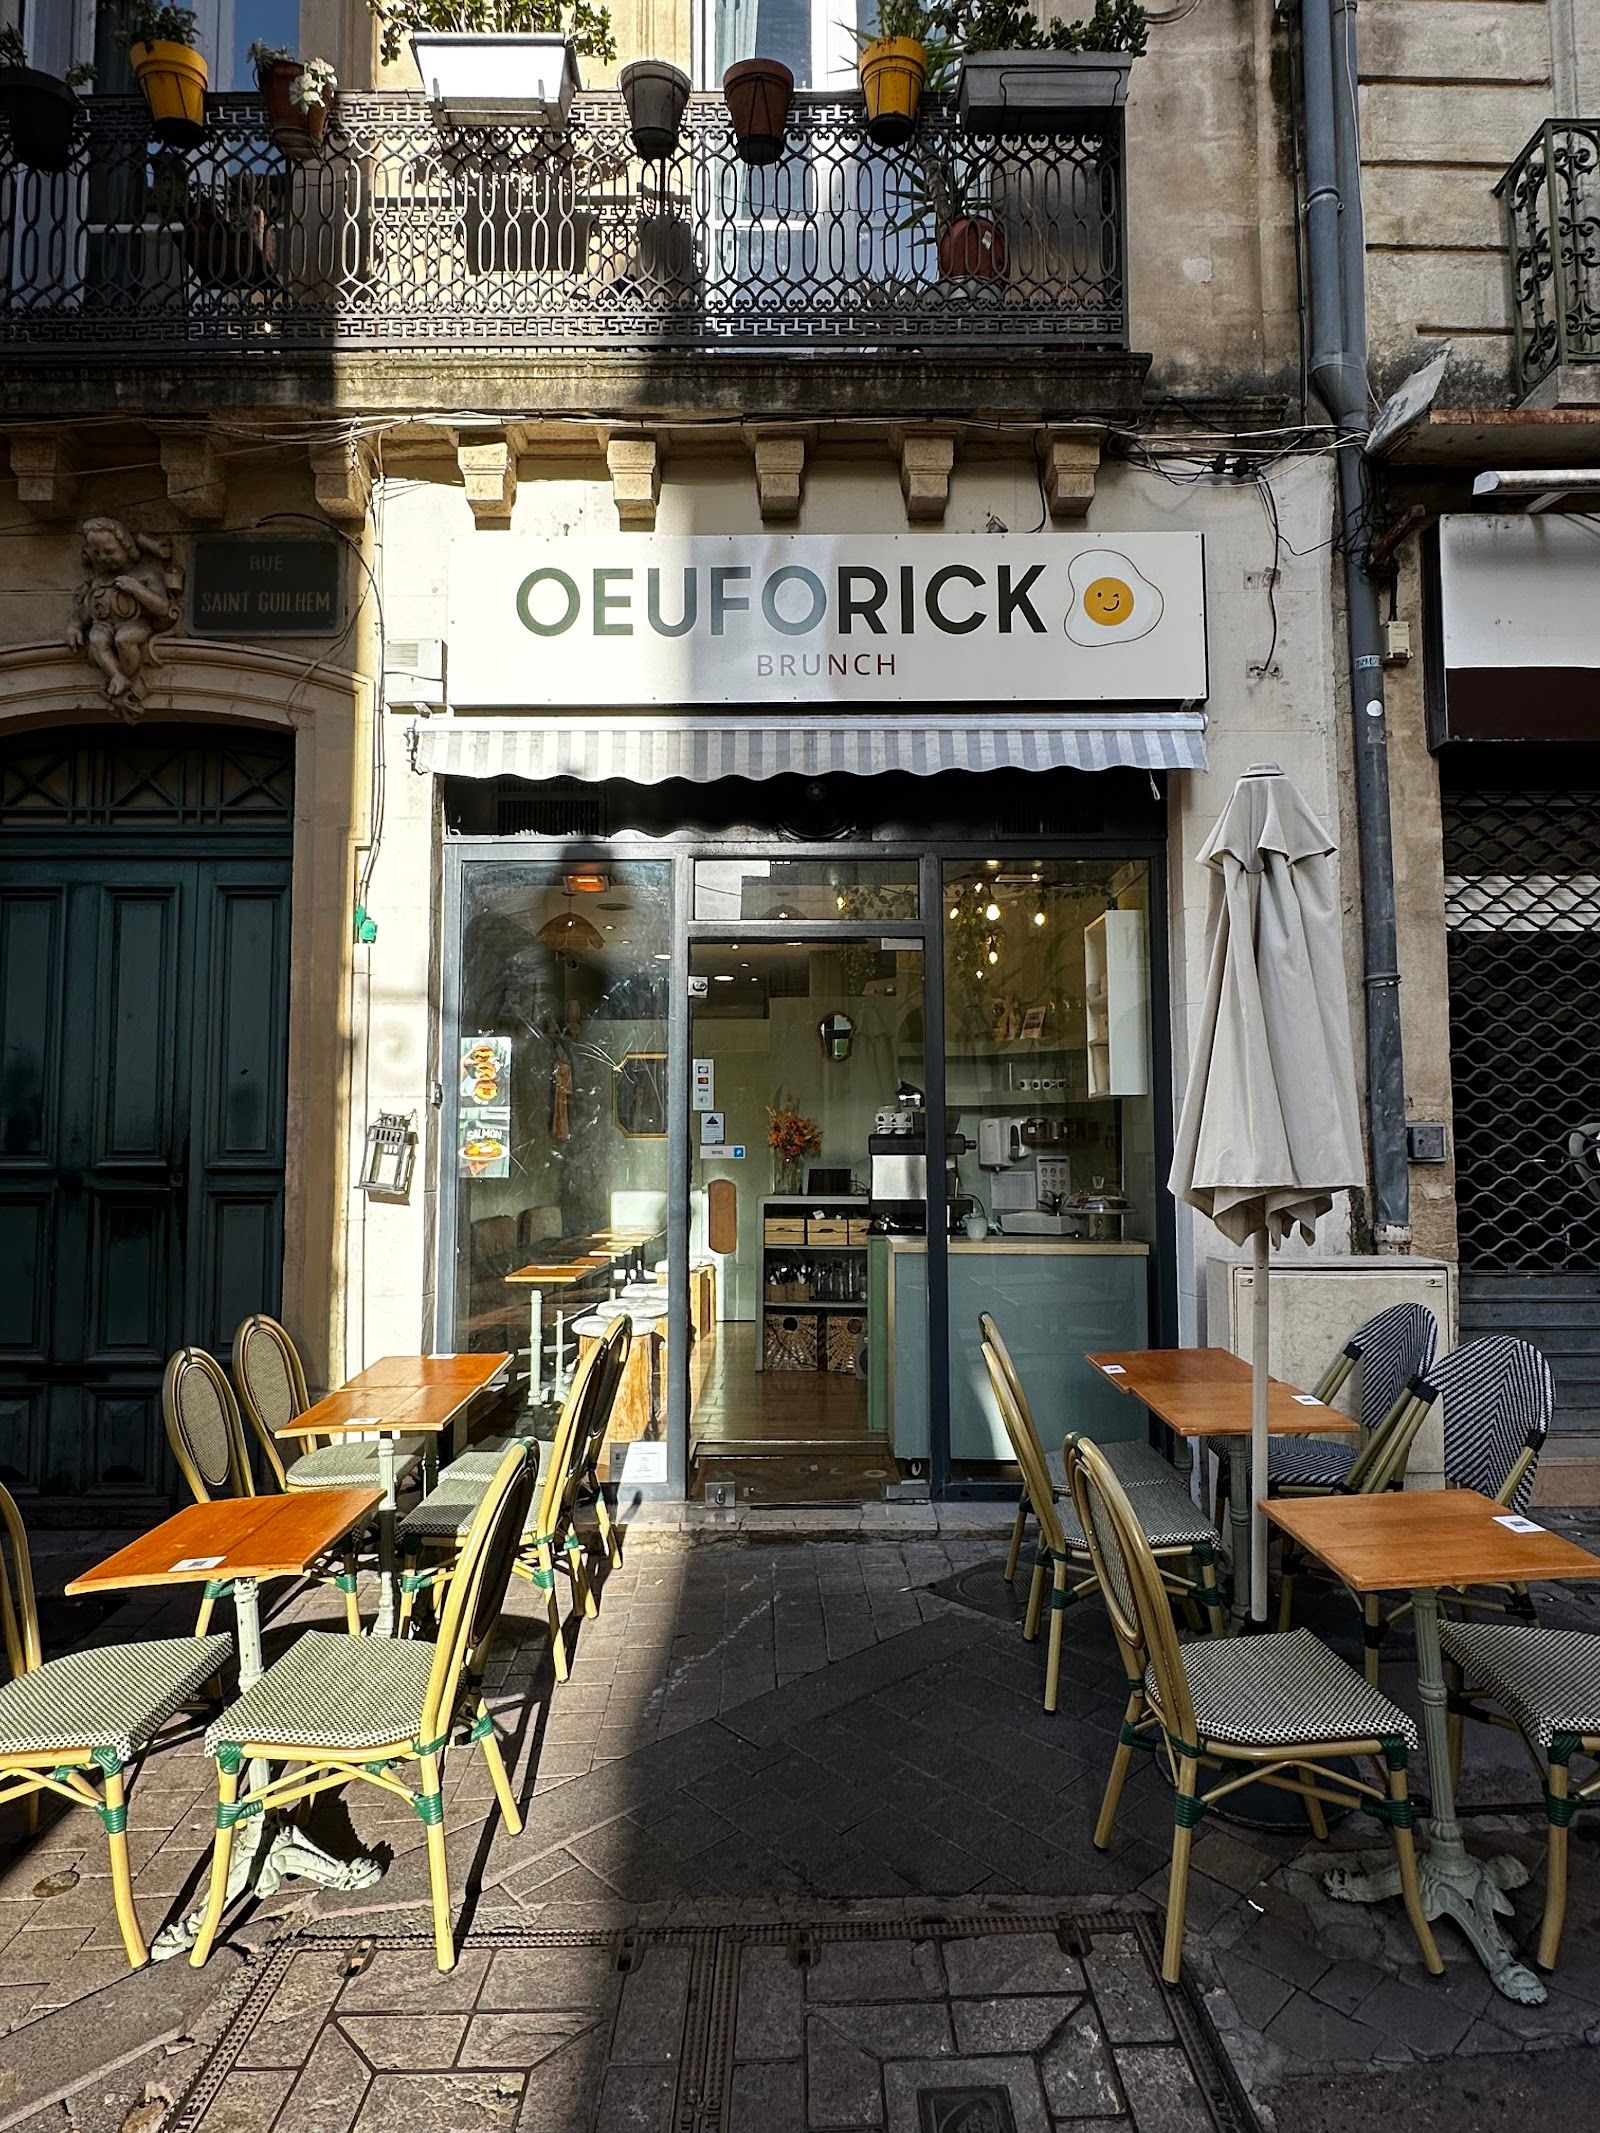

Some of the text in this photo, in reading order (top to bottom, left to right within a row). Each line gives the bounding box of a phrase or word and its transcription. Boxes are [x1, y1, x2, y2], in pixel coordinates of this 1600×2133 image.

[249, 554, 283, 572] RUE
[201, 591, 330, 613] SAINT GUILHEM
[515, 565, 1047, 636] OEUFORICK
[757, 654, 897, 676] BRUNCH
[466, 1128, 503, 1141] SALMON
